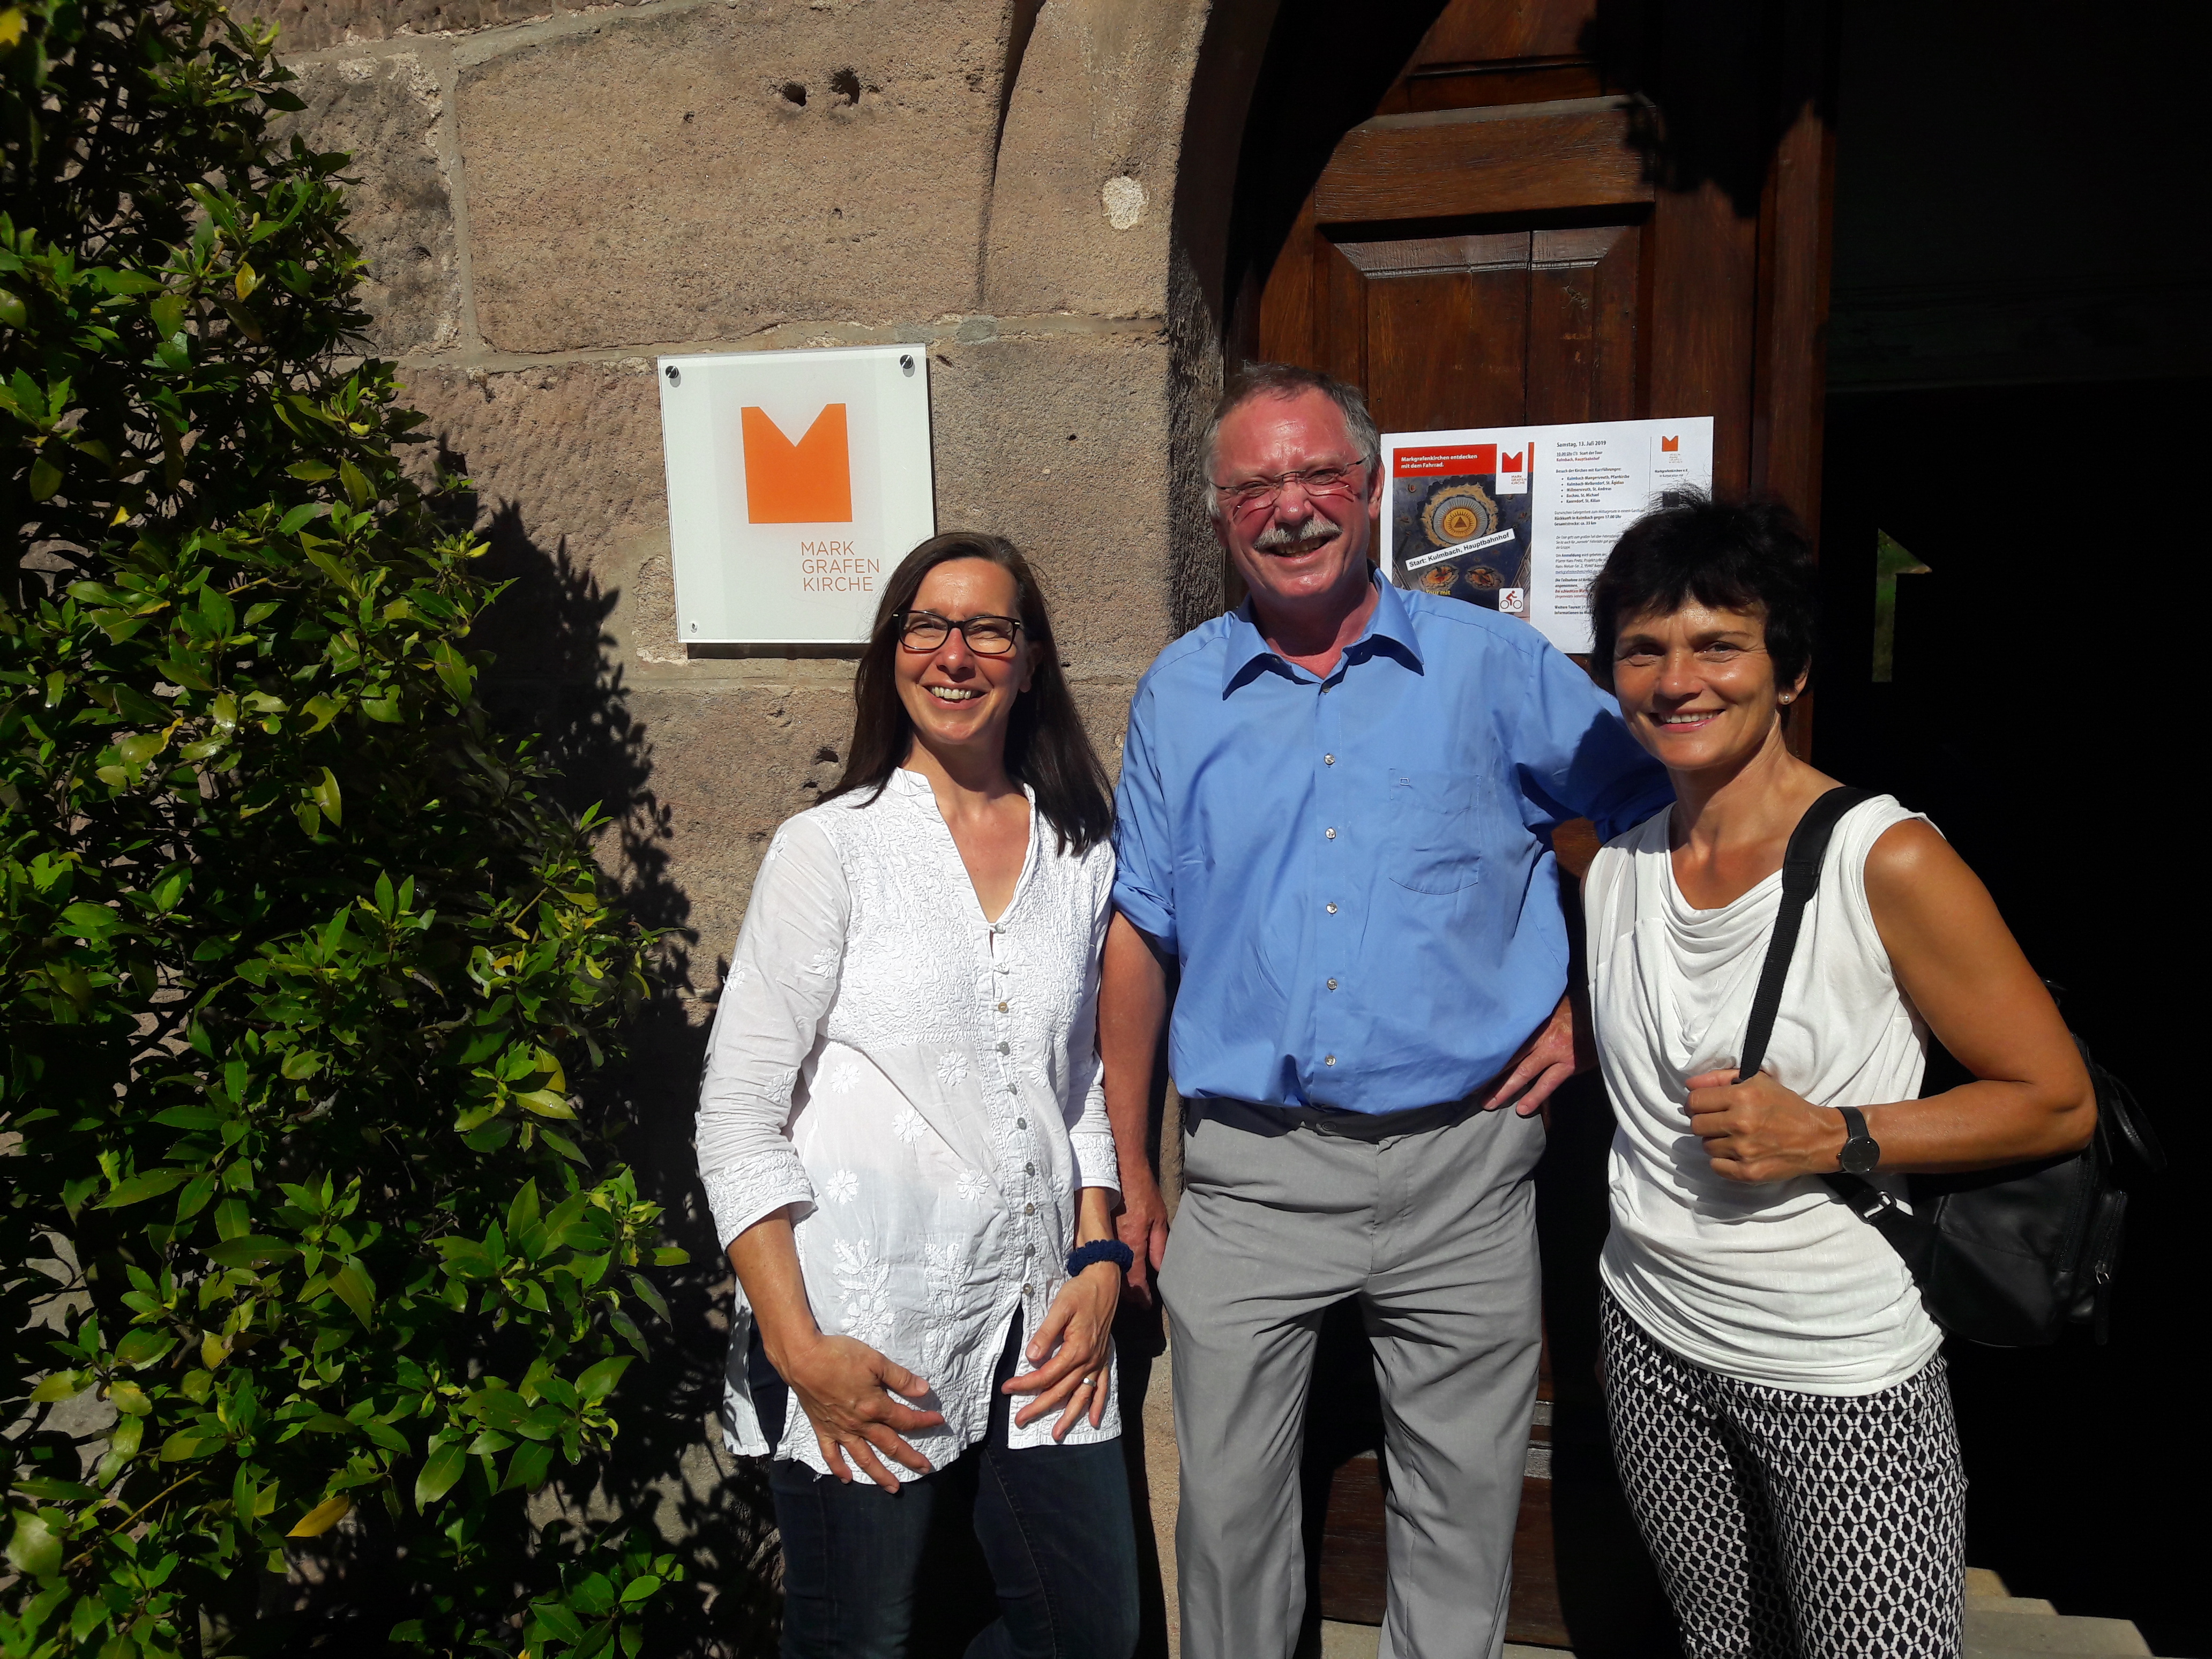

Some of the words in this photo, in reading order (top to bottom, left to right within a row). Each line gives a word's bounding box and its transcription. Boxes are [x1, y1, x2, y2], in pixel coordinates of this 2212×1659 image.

[801, 541, 855, 556] MARK
[1409, 558, 1427, 567] Start:
[1428, 547, 1462, 562] Kulmbach,
[1463, 532, 1509, 551] Hauptbahnhof
[802, 558, 880, 574] GRAFEN
[803, 577, 873, 592] KIRCHE
